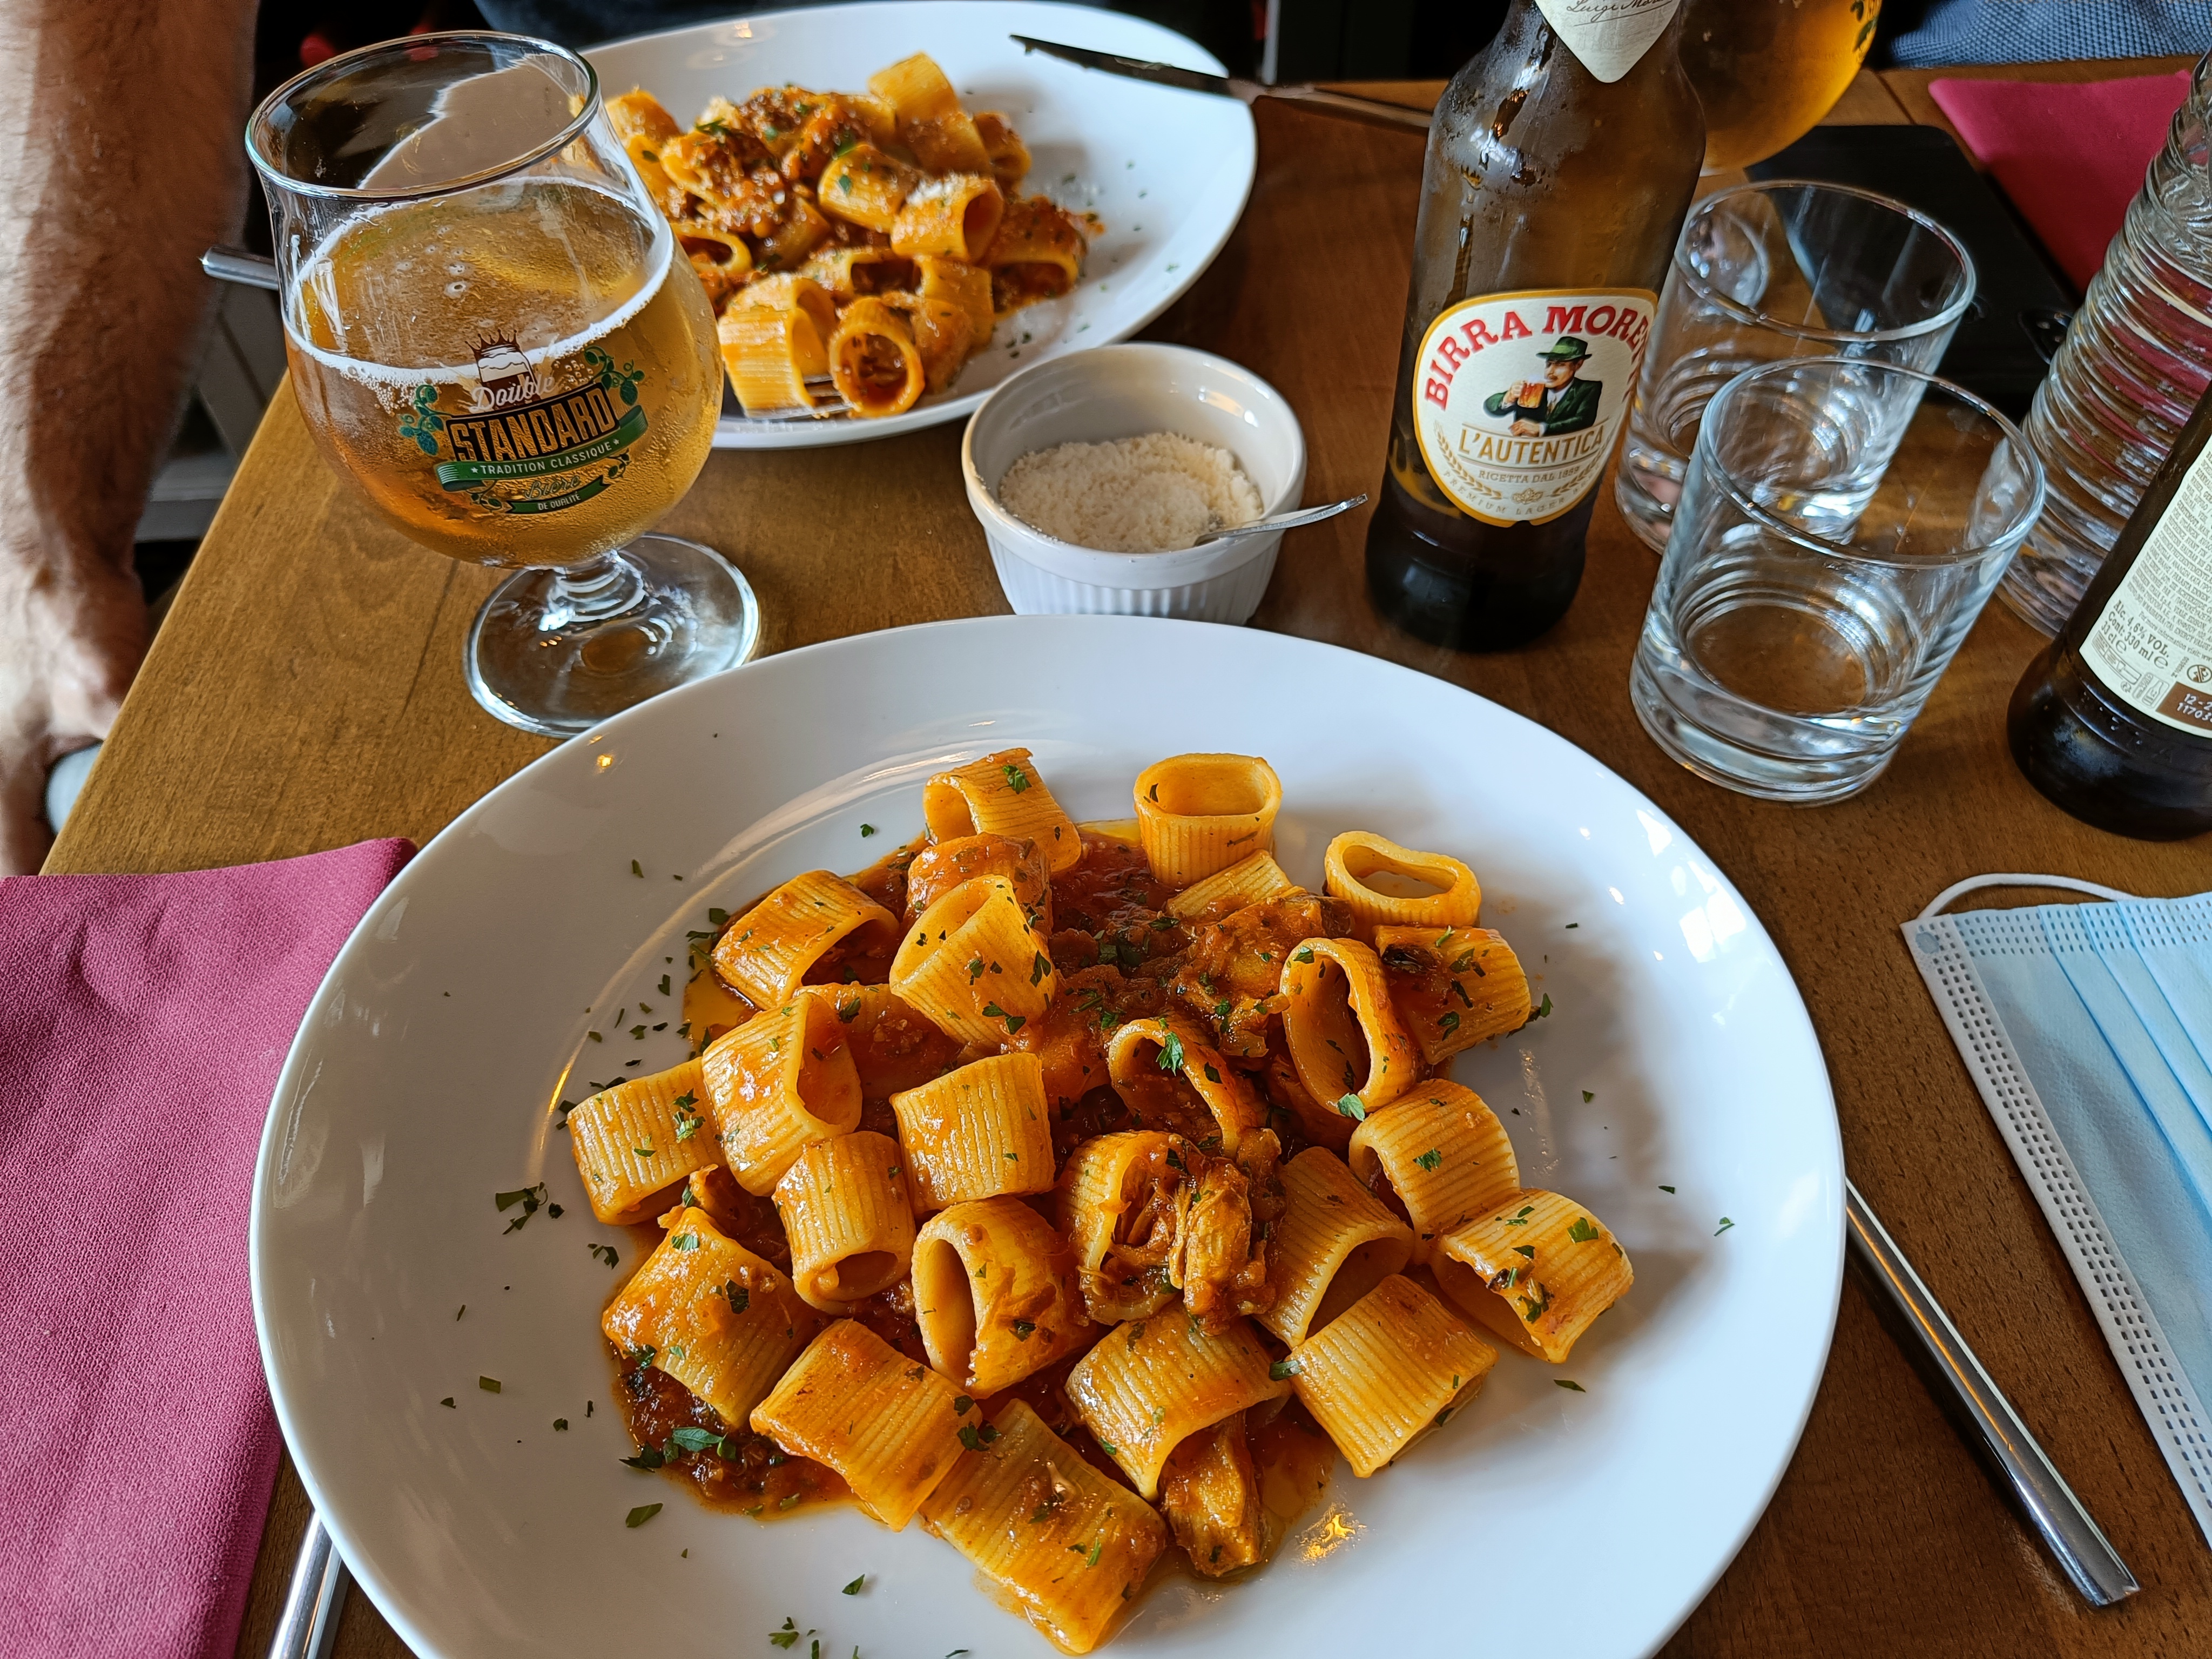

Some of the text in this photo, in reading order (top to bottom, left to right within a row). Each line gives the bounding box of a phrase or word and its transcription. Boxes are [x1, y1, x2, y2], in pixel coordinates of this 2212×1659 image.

[1425, 311, 1533, 410] BIRRA
[469, 374, 555, 414] Double
[449, 387, 615, 462] STANDARD
[1459, 424, 1606, 465] L'AUTENTICA
[480, 441, 611, 475] TRADITION CLASSIQUE
[1478, 470, 1530, 483] RICETTA
[1532, 473, 1554, 482] DAL
[538, 491, 581, 510] DE QUALITÉ
[1444, 470, 1565, 515] PREMIUM LAGER
[2101, 621, 2110, 635] 33
[2108, 632, 2117, 644] cl
[2108, 611, 2126, 636] Cont:
[2125, 632, 2140, 650] 330
[2138, 647, 2154, 661] ml
[2113, 600, 2169, 658] Alc. 4,6% VOL.
